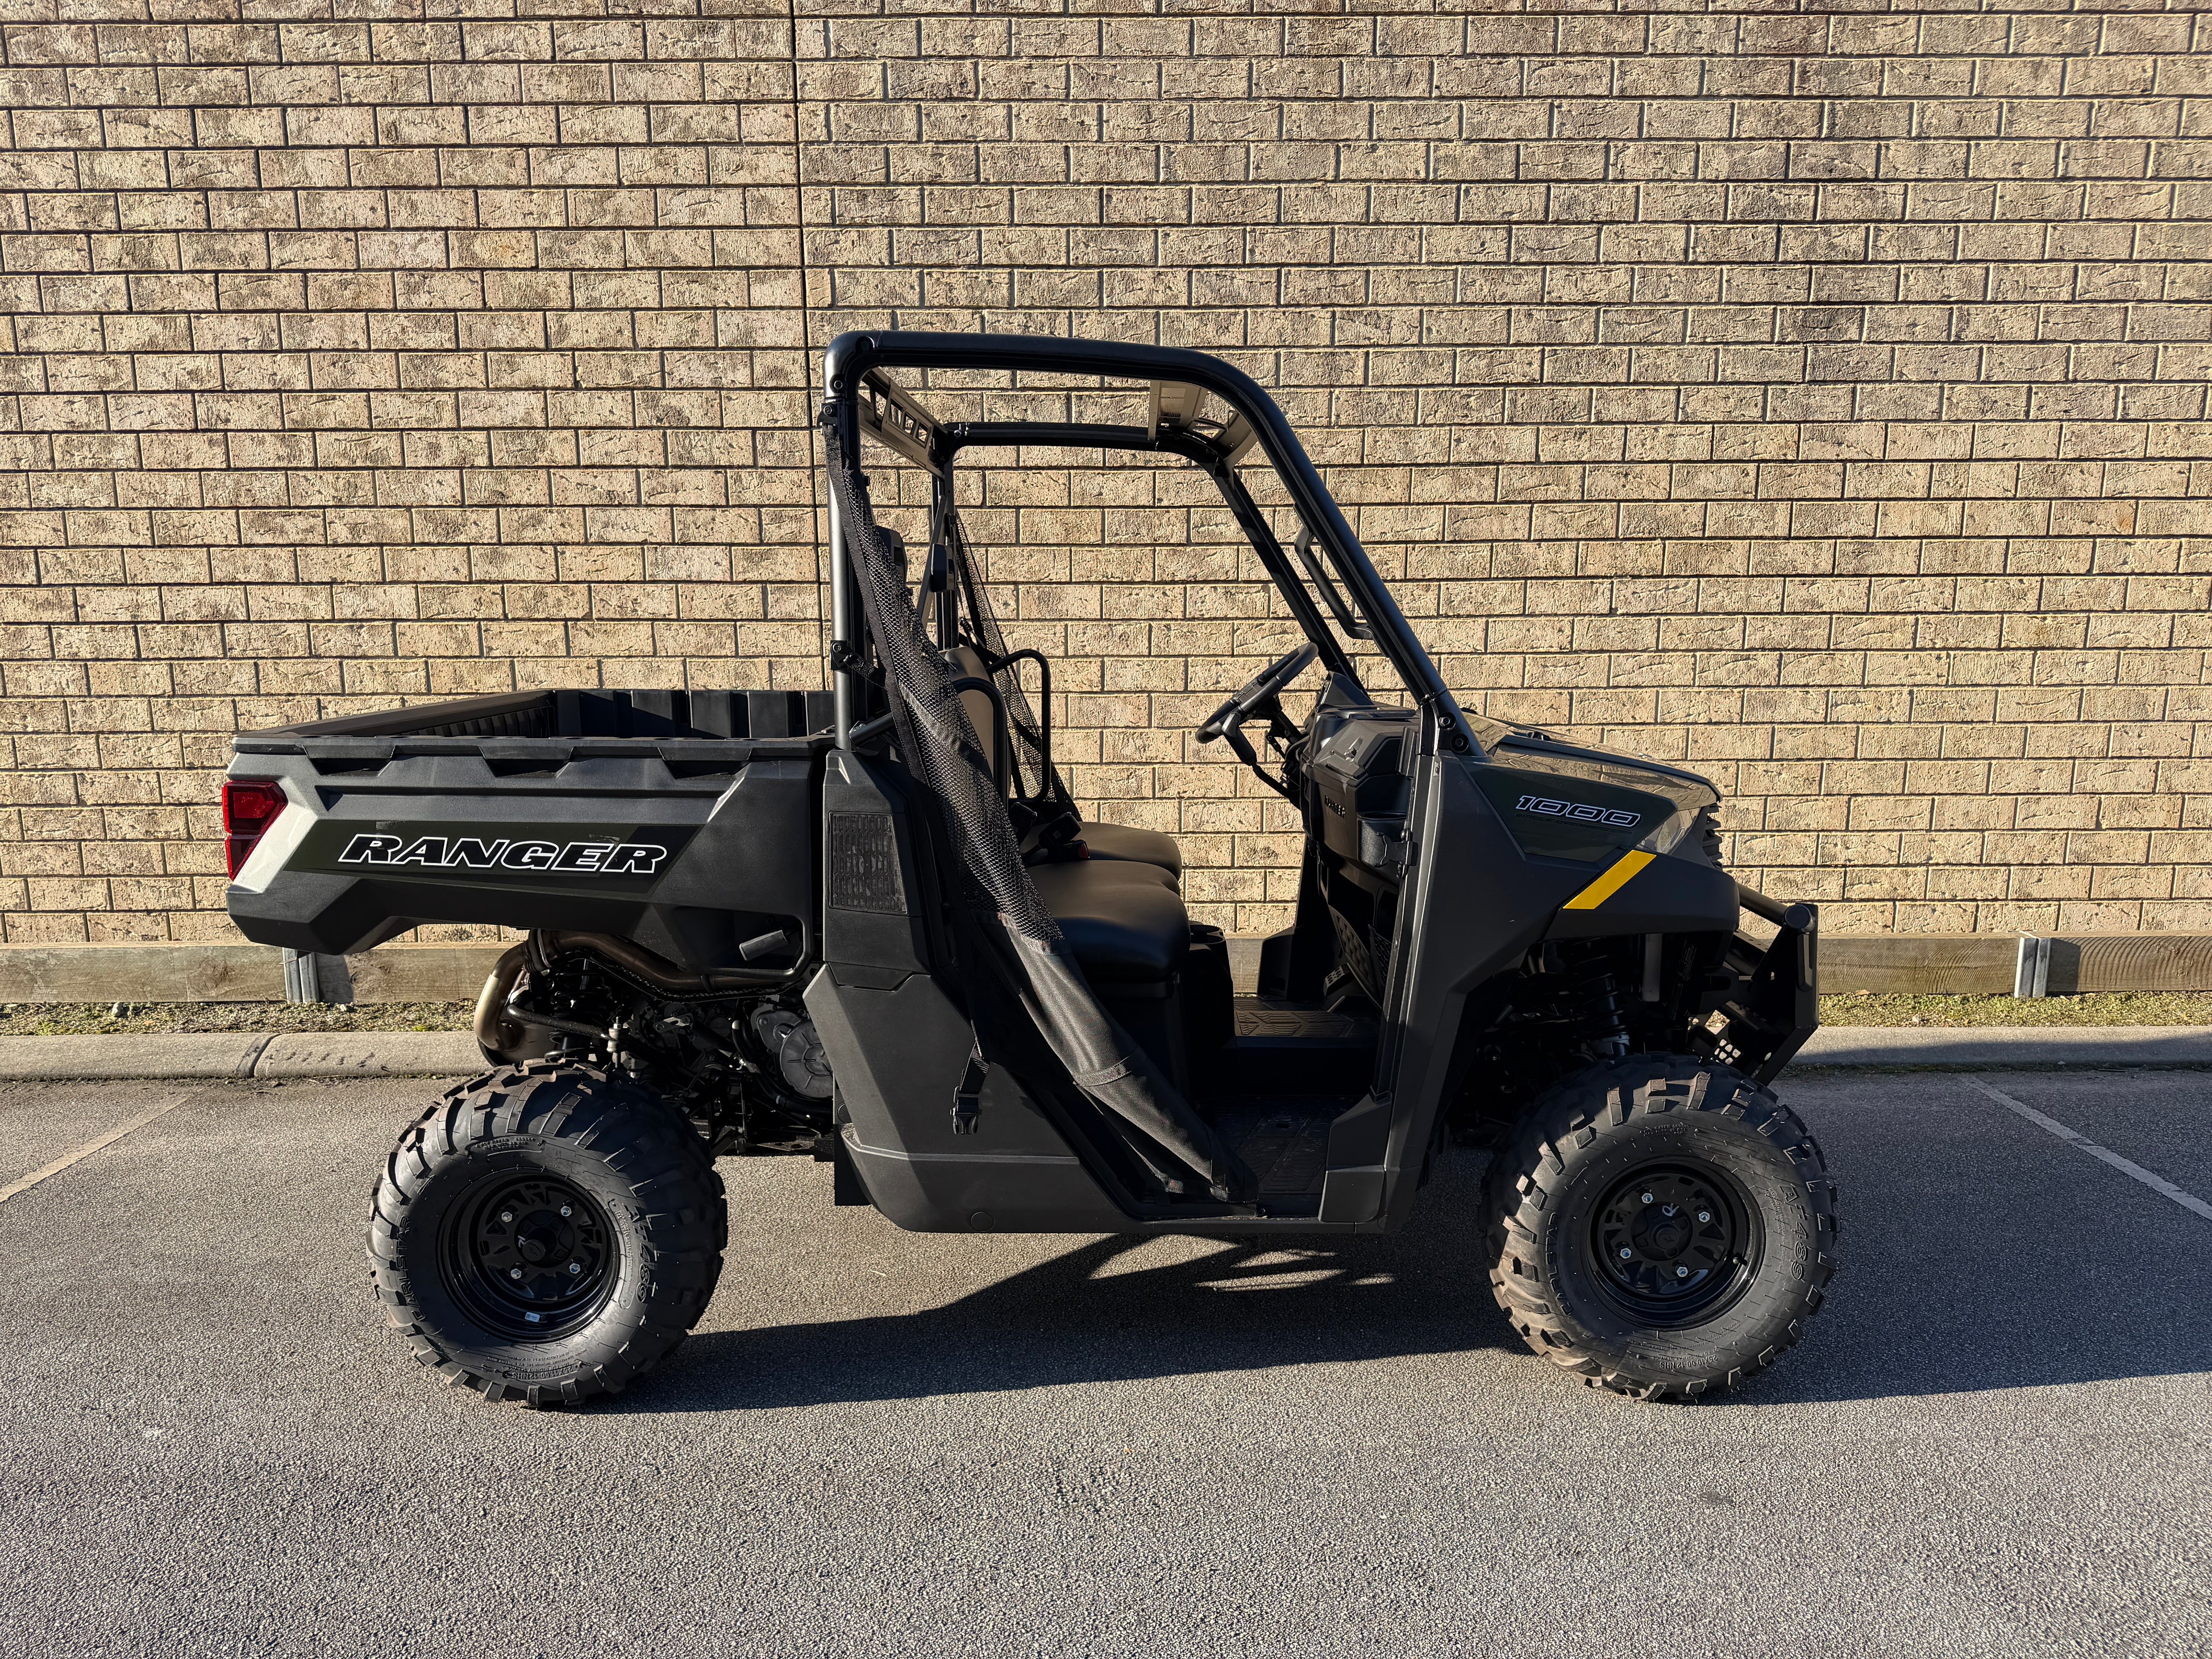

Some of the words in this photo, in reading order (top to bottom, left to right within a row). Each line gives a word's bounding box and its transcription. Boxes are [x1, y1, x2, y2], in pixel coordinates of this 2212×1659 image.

[1516, 795, 1641, 827] 1000
[338, 834, 667, 873] RANGER
[1545, 1212, 1574, 1316] CARLSTAR
